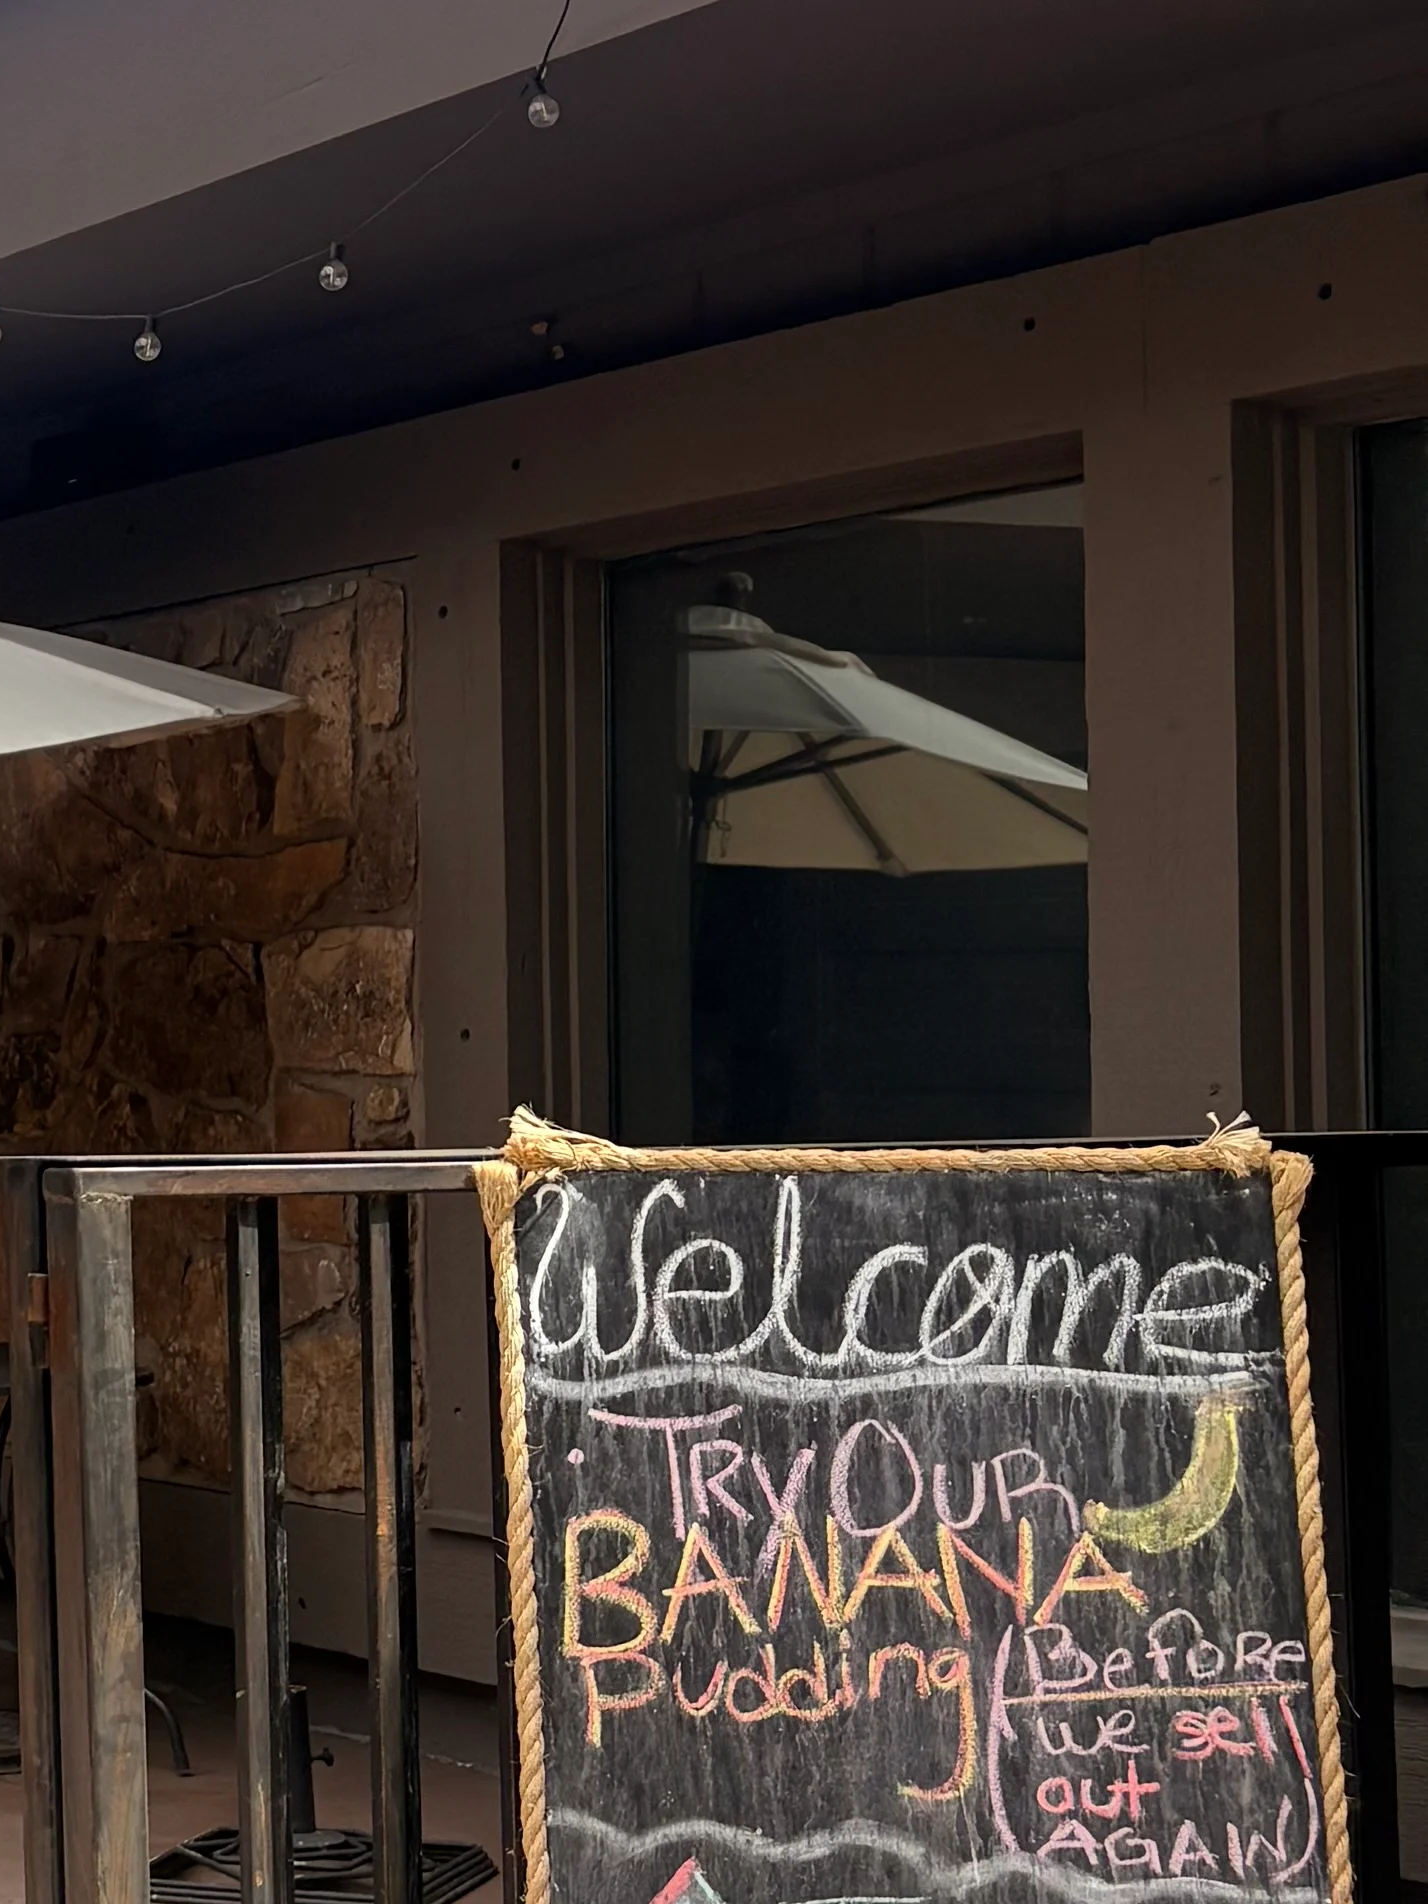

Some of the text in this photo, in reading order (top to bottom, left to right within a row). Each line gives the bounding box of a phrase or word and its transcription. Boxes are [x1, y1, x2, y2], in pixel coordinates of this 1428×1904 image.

[530, 1175, 1281, 1366] Welcome
[562, 1508, 1148, 1658] BANANA
[1036, 1759, 1161, 1823] out
[1170, 1694, 1313, 1780] sell
